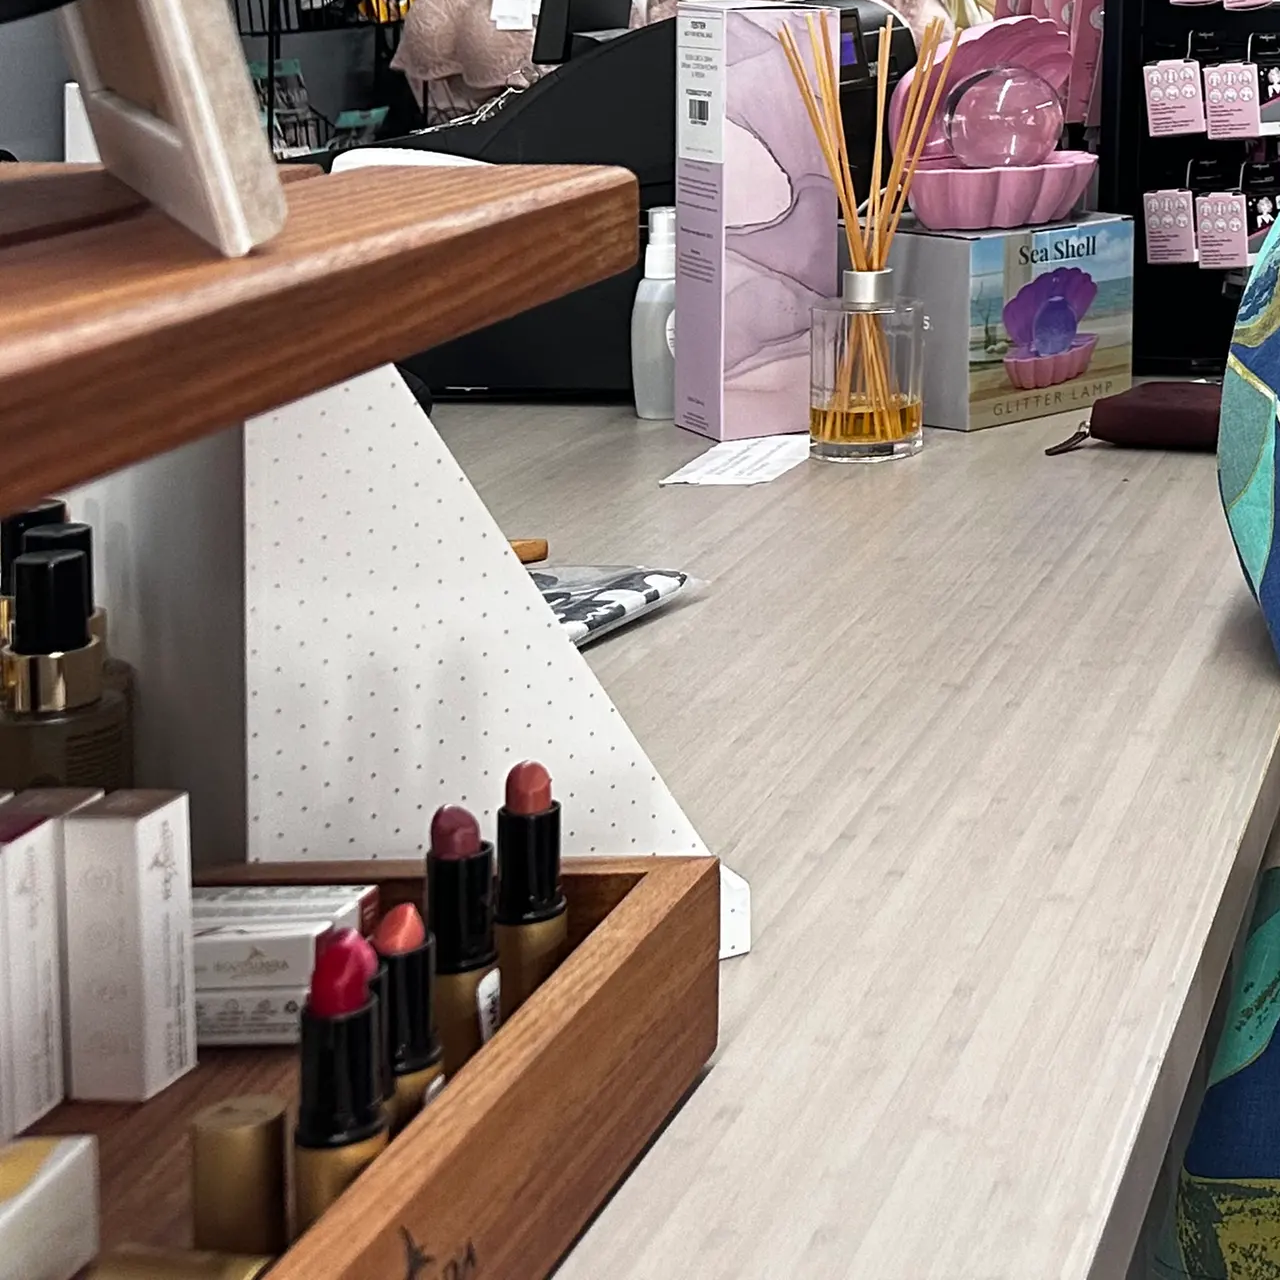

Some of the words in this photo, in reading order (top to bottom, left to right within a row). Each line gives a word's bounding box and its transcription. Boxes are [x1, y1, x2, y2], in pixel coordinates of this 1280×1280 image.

[1018, 245, 1049, 266] Sea
[1053, 235, 1097, 261] Shell
[993, 391, 1063, 417] GLITTER
[1071, 380, 1114, 402] LAMP
